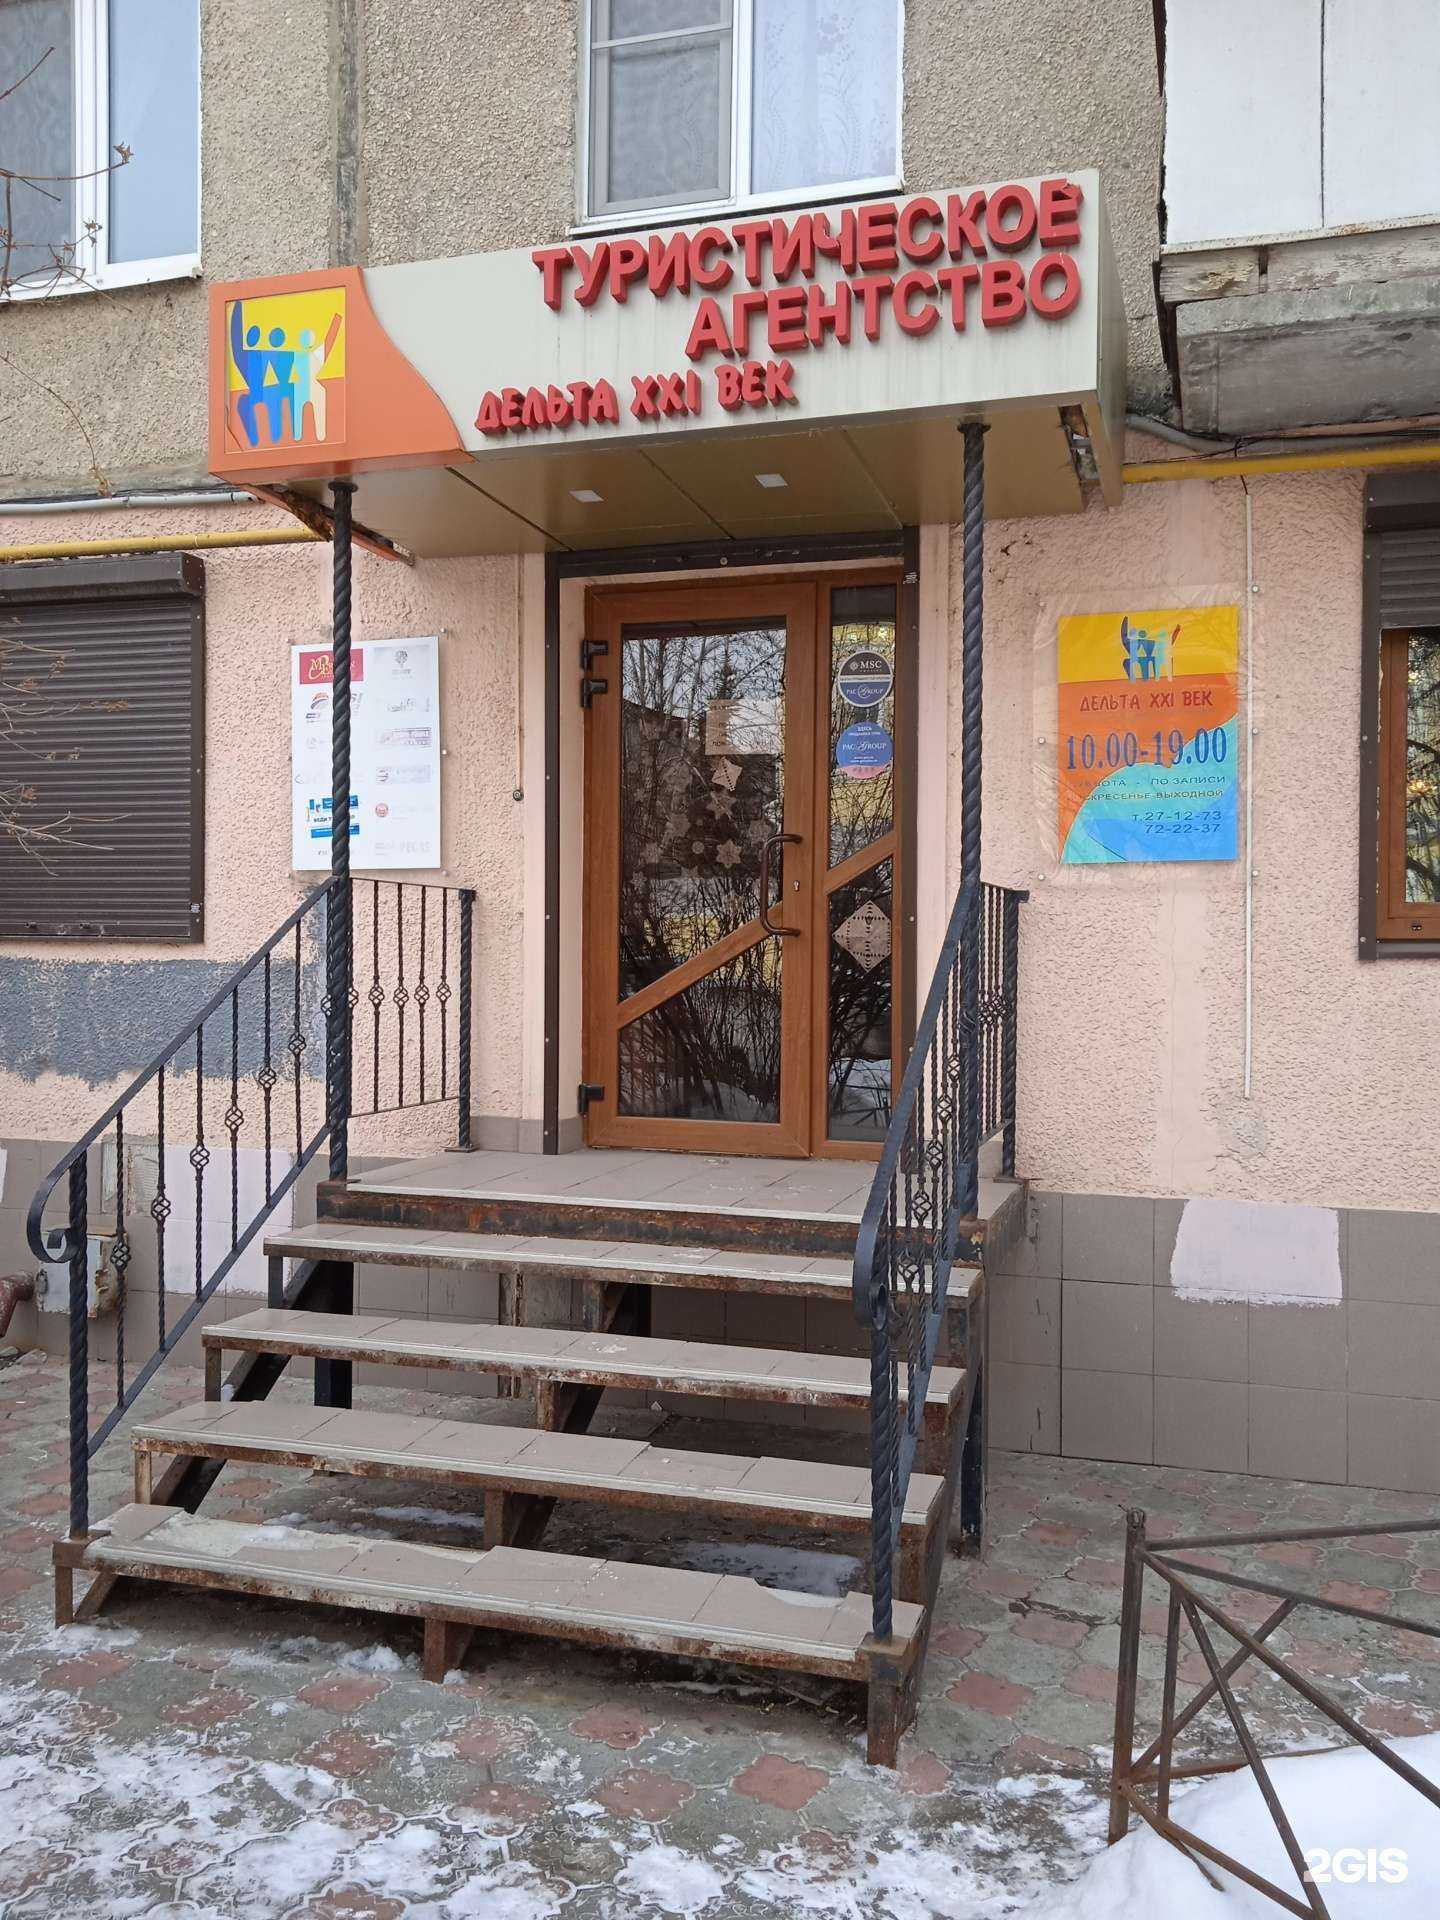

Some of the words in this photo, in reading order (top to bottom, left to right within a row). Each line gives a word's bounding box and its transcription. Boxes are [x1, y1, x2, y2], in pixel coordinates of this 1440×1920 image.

[532, 179, 1083, 310] ТУРИСТИЧЕСКОЕ
[685, 252, 1081, 361] АГЕНТСТВО
[475, 377, 619, 436] ДЕЛЬТА
[715, 358, 798, 408] ВЕК
[860, 660, 882, 669] MSC
[1079, 694, 1141, 712] ДЕЛЬТА
[1183, 690, 1213, 707] ВЕК
[1066, 727, 1227, 770] 10.00-19.00
[1150, 777, 1169, 786] ПО
[1172, 775, 1226, 785] ЗАПИСИ
[1145, 823, 1221, 834] 72-22-37
